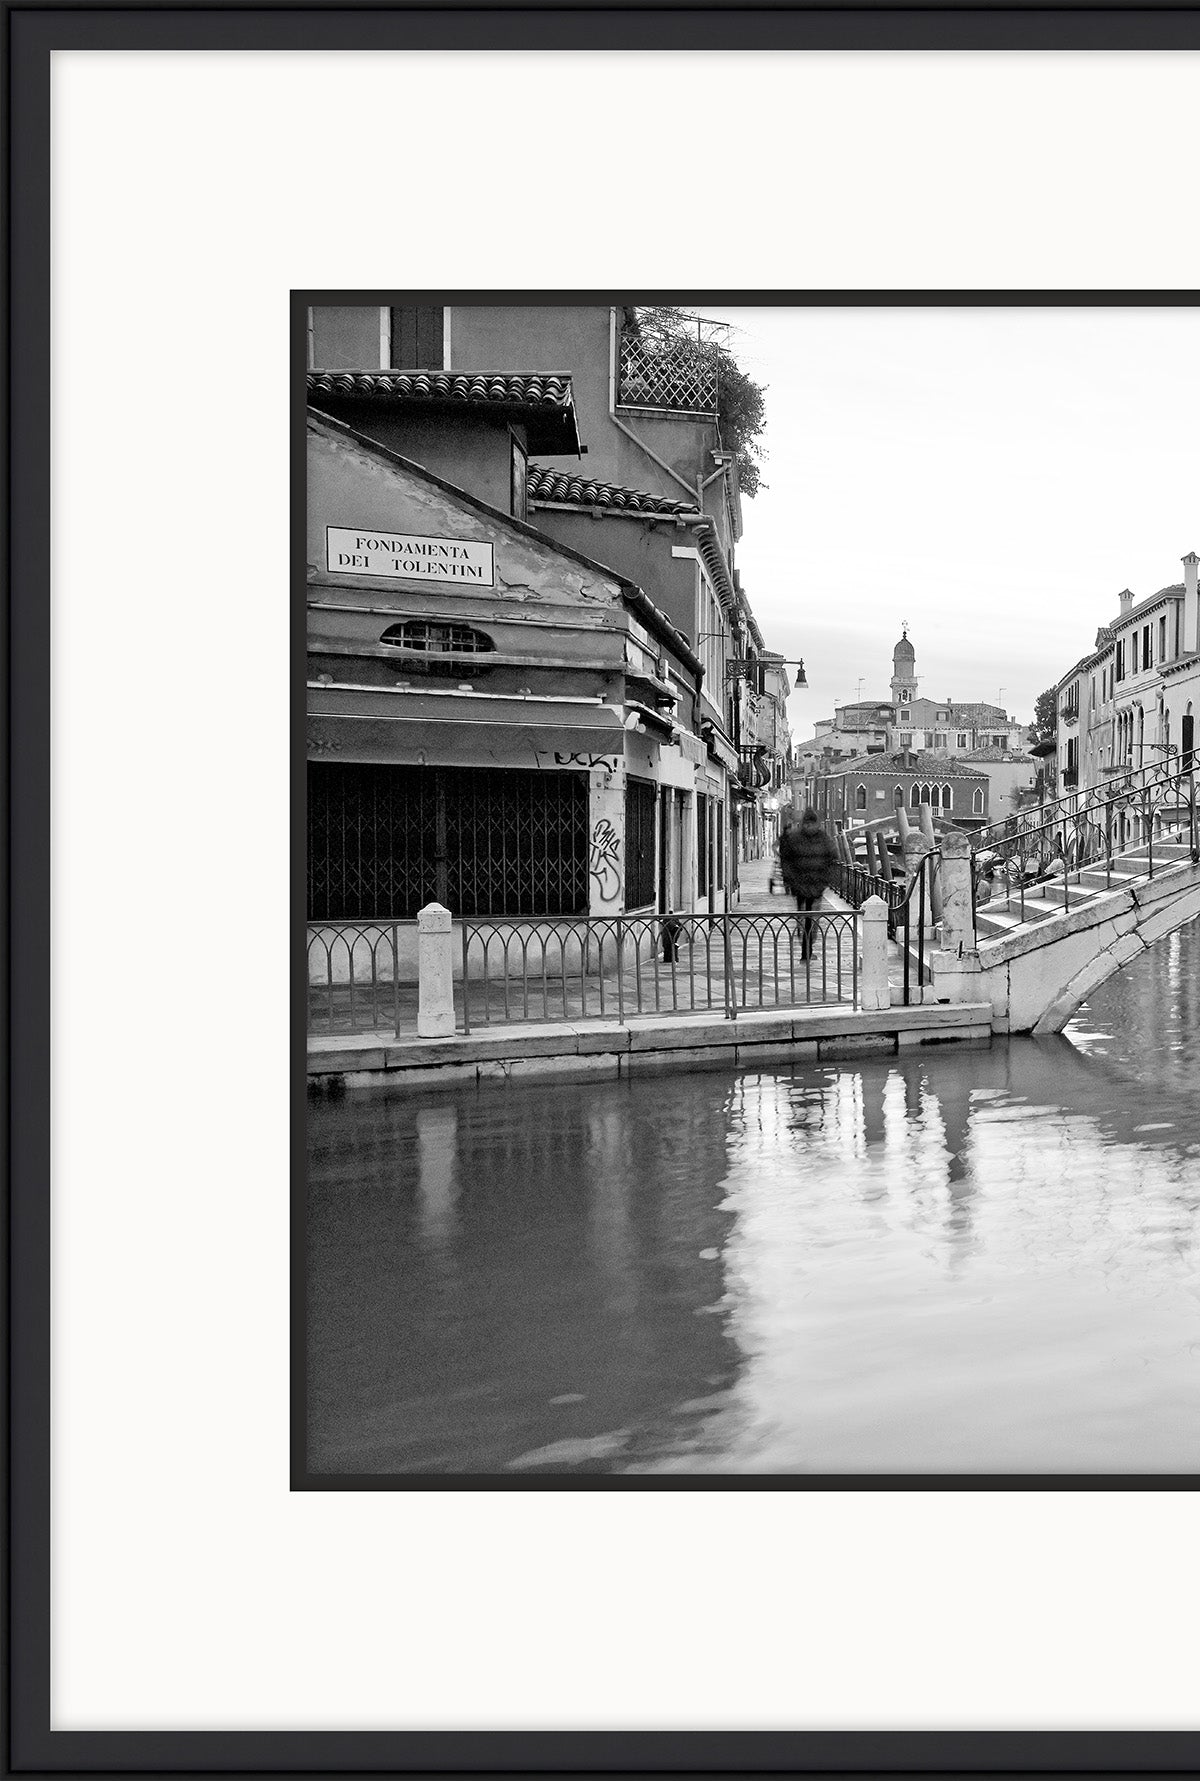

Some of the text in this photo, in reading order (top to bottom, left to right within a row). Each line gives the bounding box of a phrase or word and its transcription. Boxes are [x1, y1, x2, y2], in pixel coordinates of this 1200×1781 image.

[355, 537, 470, 560] FONDAMENTA
[338, 553, 483, 578] DEI TOLENTINI
